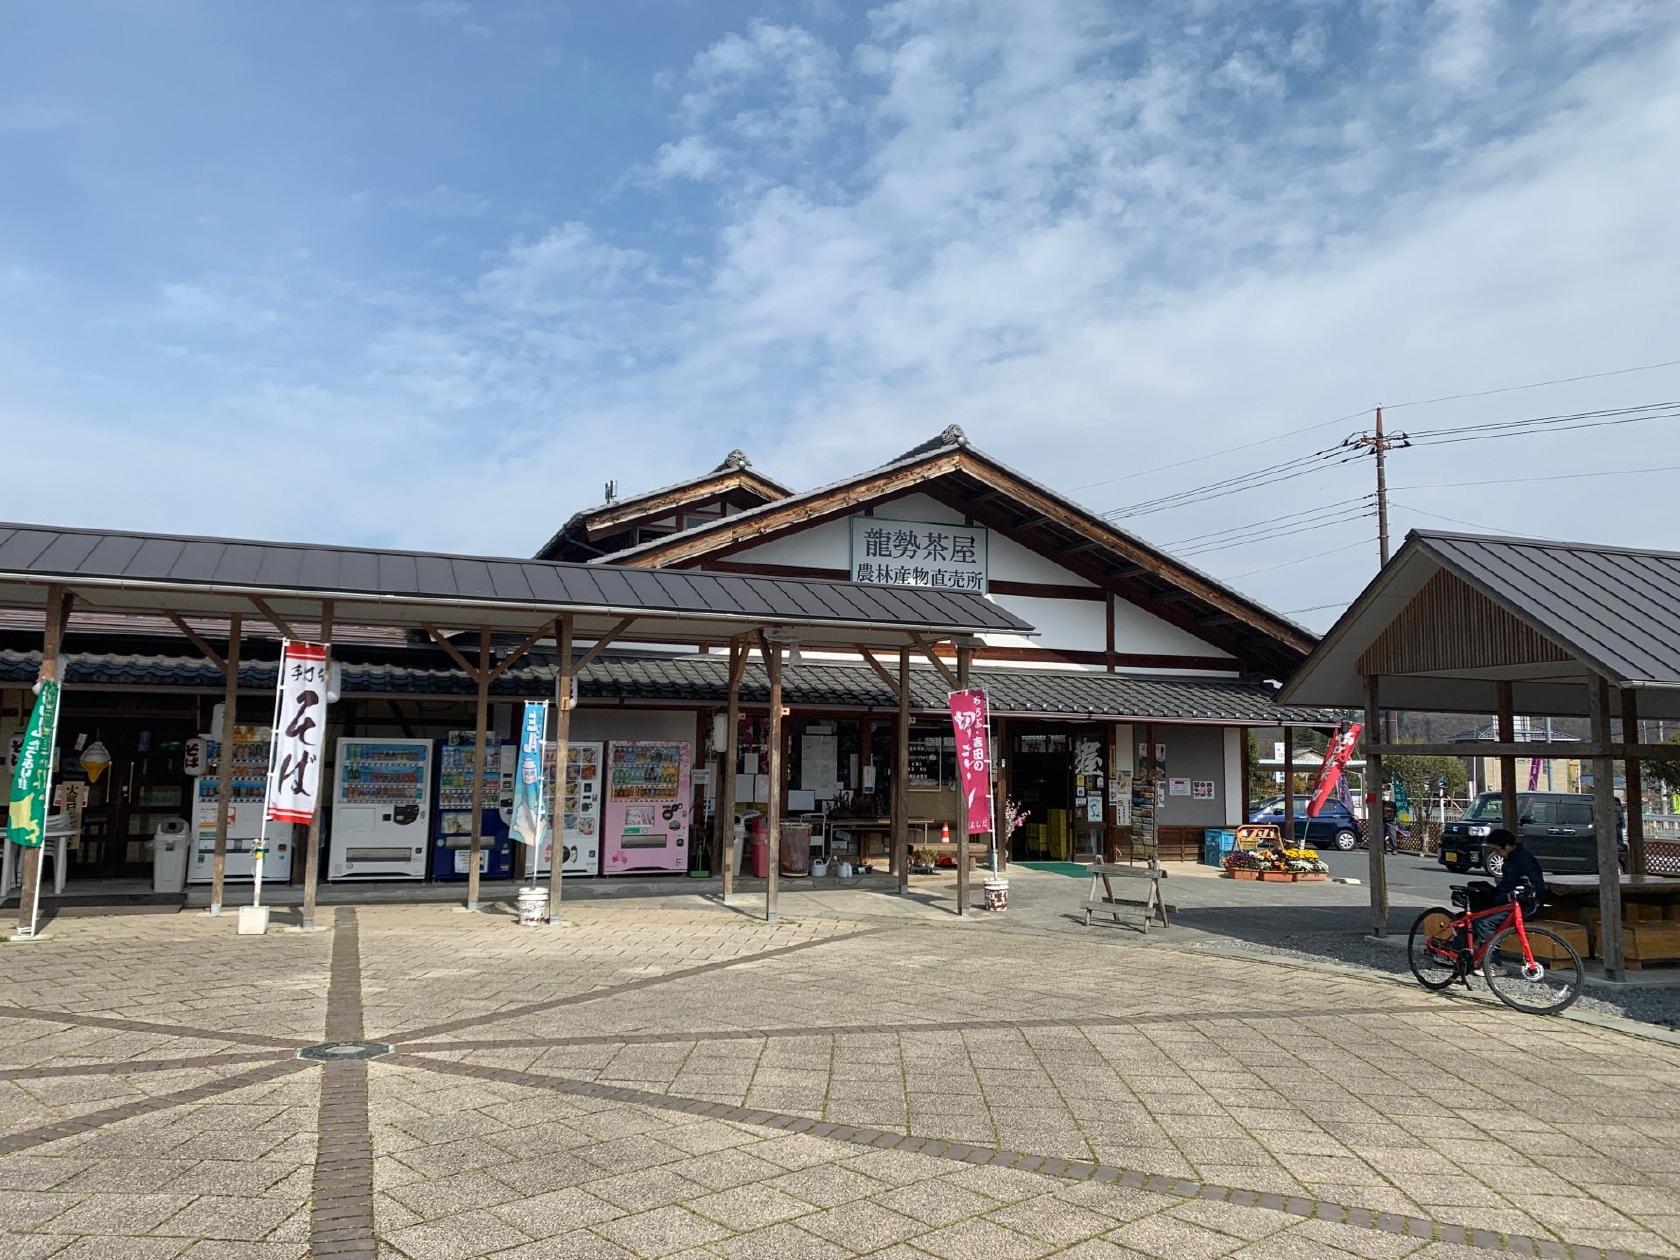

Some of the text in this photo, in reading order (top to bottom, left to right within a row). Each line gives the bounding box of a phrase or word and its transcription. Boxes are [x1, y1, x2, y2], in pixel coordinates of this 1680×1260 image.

[864, 528, 976, 563] 龍勢茶屋
[856, 563, 984, 590] 農林産物直売所
[278, 690, 319, 797] そば
